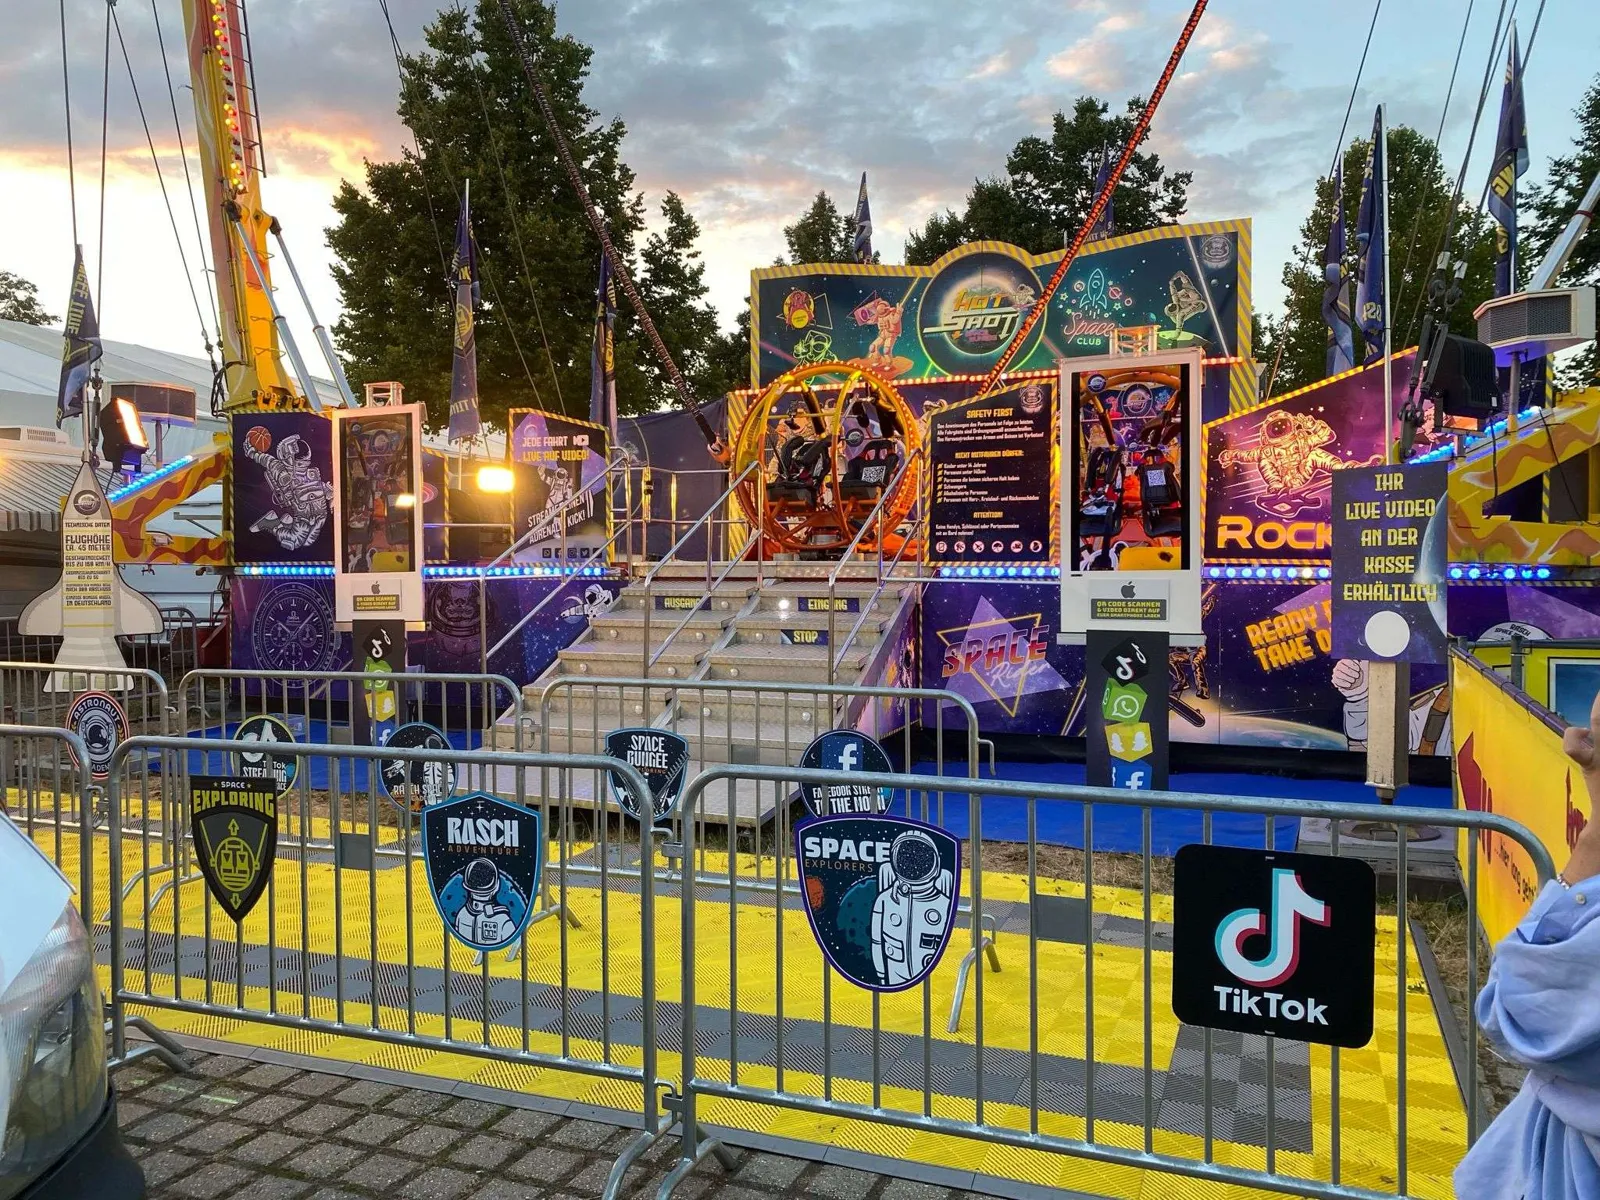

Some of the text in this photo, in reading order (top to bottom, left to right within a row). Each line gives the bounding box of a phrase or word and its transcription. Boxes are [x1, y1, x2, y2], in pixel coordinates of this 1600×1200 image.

[953, 288, 1008, 312] HOT
[923, 307, 1019, 340] SHOT
[1064, 312, 1115, 344] Space
[1077, 337, 1102, 346] CLUB
[966, 408, 1014, 418] SAFETY FIRST
[522, 436, 568, 447] JEDE FAHRT
[523, 449, 591, 461] LIVE AUF VIDEO!
[1375, 473, 1404, 491] IHR
[1345, 499, 1436, 520] LIVE VIDEO
[530, 509, 586, 544] ADRENAL KICK!
[65, 534, 111, 544] FLUGHÖHE
[1361, 528, 1418, 547] AN DER
[1364, 556, 1415, 574] KASSE
[1343, 581, 1438, 602] ERHÄLTLICH
[808, 599, 848, 610] EINGNG
[1245, 605, 1318, 647] READY
[1510, 624, 1531, 636] RASCH
[793, 630, 818, 643] STOP
[942, 625, 1050, 677] SPACE
[1254, 635, 1315, 672] TAKE
[74, 698, 121, 722] ASTRONAUT
[631, 734, 665, 752] SPACE
[626, 750, 669, 769] BUNGEE
[220, 781, 246, 789] SPACE
[393, 783, 443, 795] RACH SPAC
[812, 785, 883, 799] FAEBOOK STREM
[193, 789, 275, 818] EXPLORING
[830, 797, 853, 814] THE
[854, 795, 886, 812] MON
[447, 817, 519, 847] RASCH
[447, 845, 520, 856] ADVENTURE
[804, 836, 891, 862] SPACE
[804, 858, 874, 873] EXPLORERS
[1213, 985, 1330, 1026] TikTok
